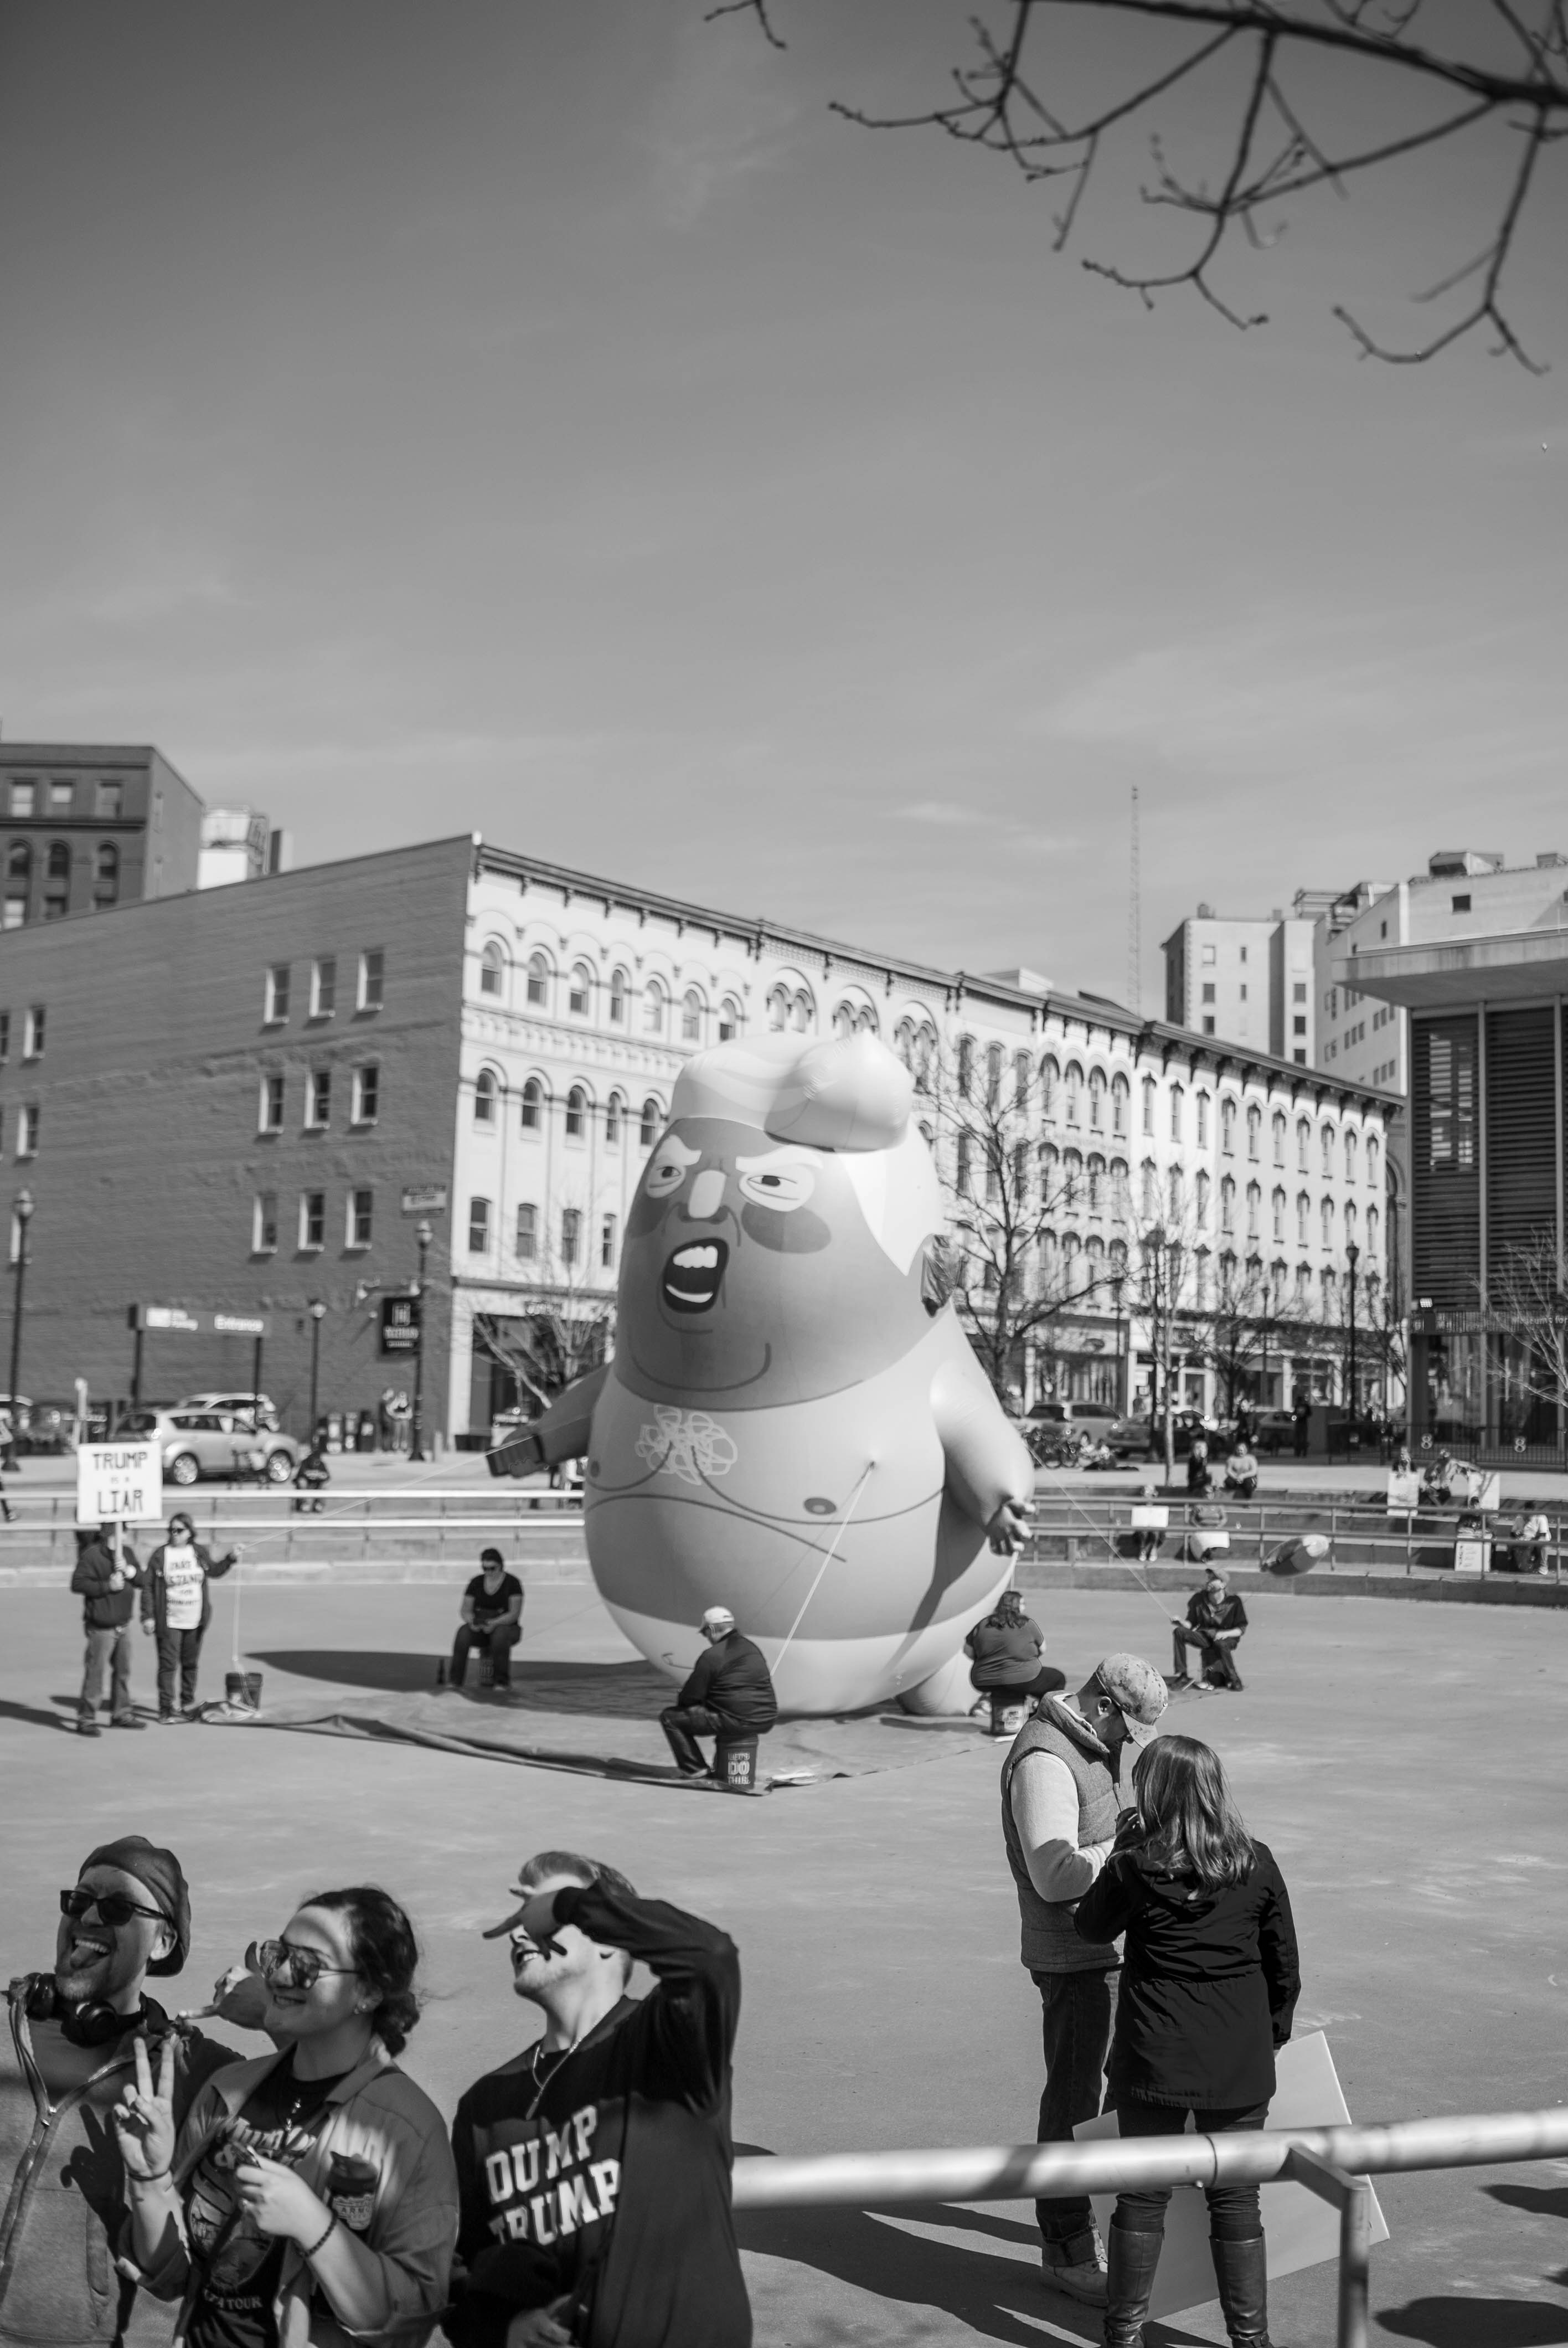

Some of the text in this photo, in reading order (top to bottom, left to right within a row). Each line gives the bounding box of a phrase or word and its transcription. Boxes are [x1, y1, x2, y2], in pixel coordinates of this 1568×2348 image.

[214, 1315, 264, 1332] Entrance
[92, 1451, 147, 1471] TRUMP
[97, 1490, 143, 1514] LIAR
[728, 1761, 750, 1775] DO
[486, 2105, 597, 2205] DUMP
[226, 2295, 263, 2310] TOUR
